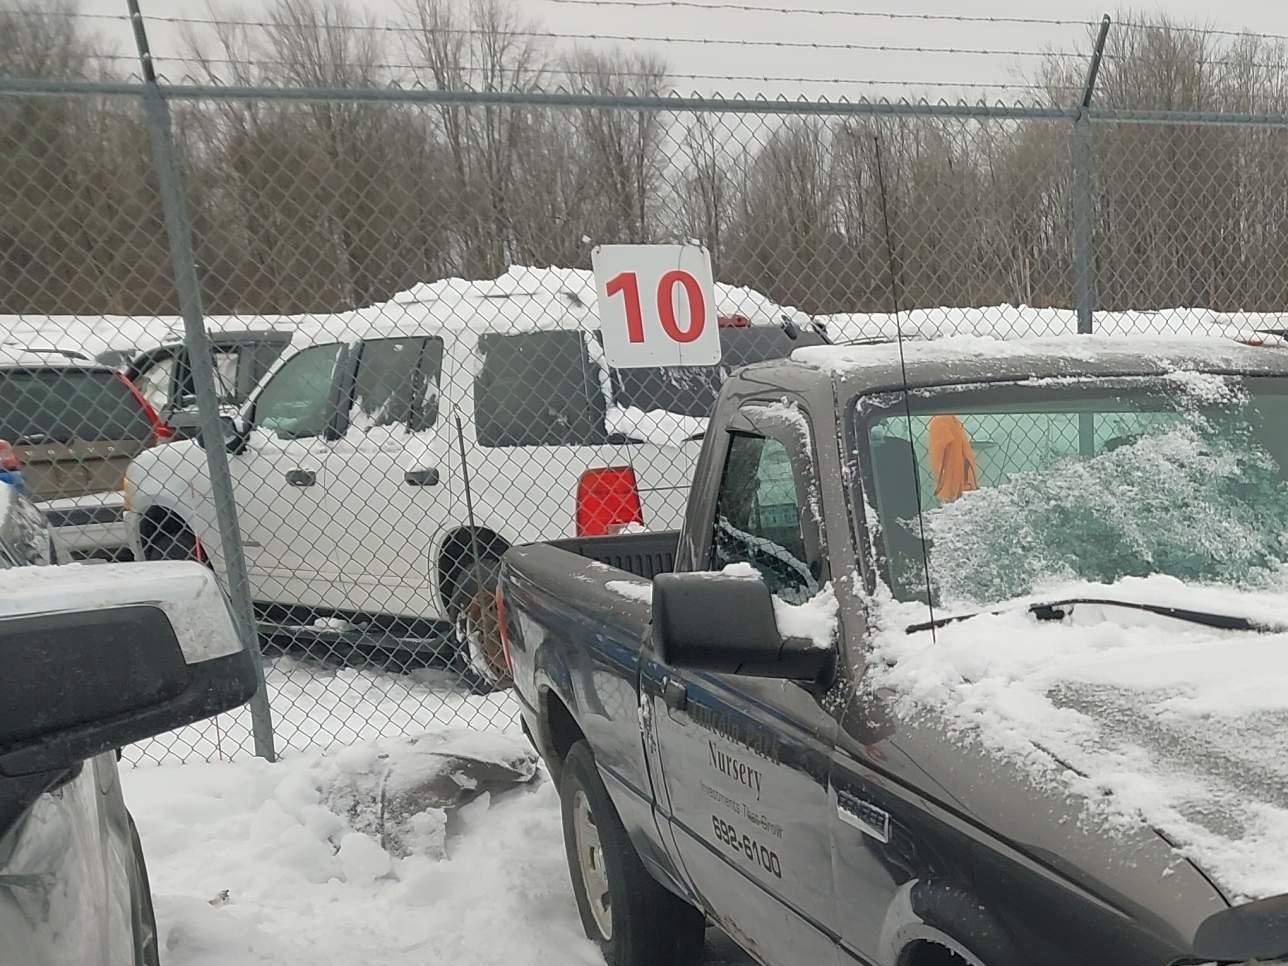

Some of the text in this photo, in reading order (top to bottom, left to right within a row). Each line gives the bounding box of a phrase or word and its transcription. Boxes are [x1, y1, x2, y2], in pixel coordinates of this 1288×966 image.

[606, 270, 705, 344] 10
[708, 740, 763, 801] Nursery
[711, 814, 782, 879] 692-6100
